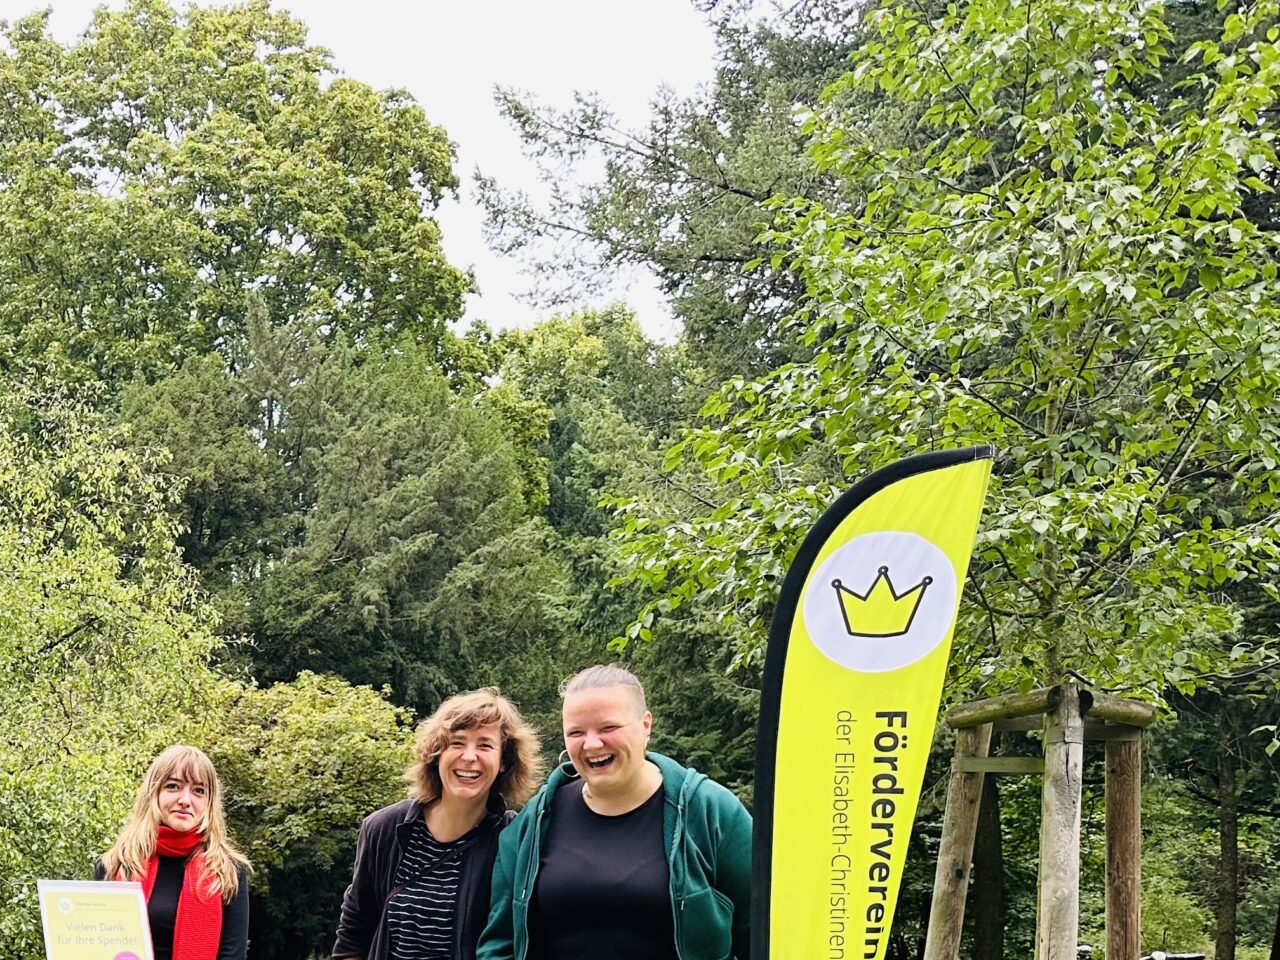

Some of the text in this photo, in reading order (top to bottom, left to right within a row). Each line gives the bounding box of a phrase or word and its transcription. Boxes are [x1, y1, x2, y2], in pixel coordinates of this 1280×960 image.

[835, 710, 857, 745] der
[863, 711, 908, 960] Förderverein
[65, 922, 126, 932] Vielen Dank
[74, 935, 96, 945] Ihre
